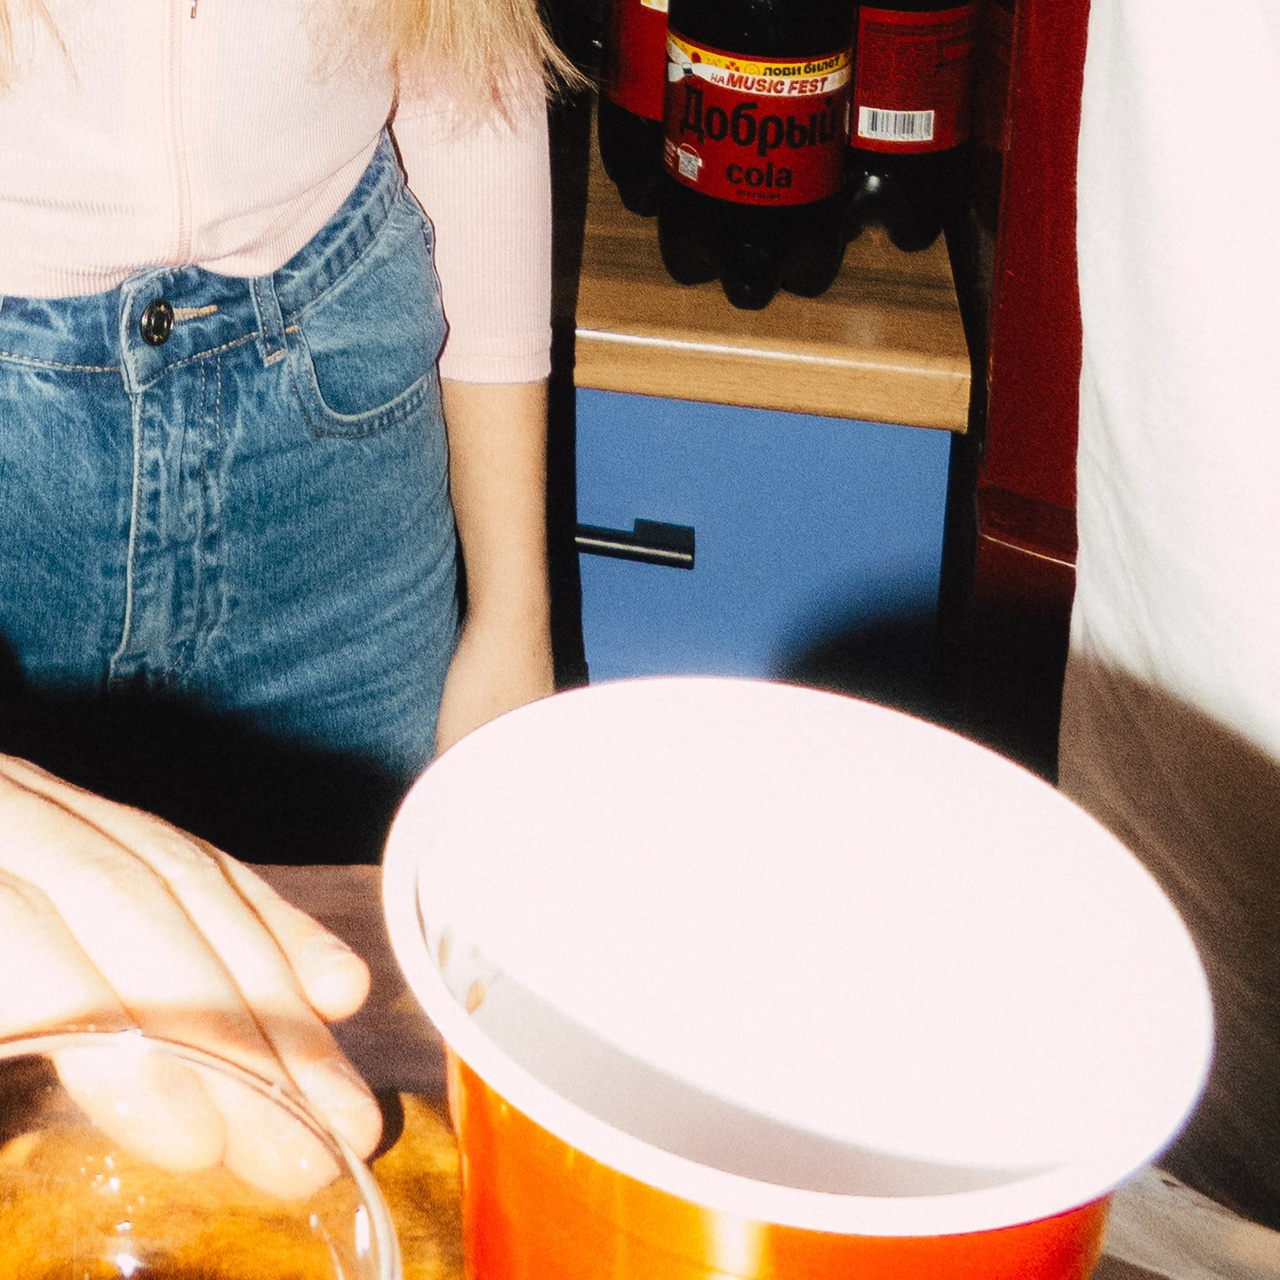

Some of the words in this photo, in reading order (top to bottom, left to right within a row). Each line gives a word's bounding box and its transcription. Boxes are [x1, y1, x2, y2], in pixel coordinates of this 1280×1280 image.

[726, 72, 785, 94] MUSIC
[787, 76, 829, 95] FEST
[680, 83, 838, 157] Добрый
[726, 161, 793, 189] cola
